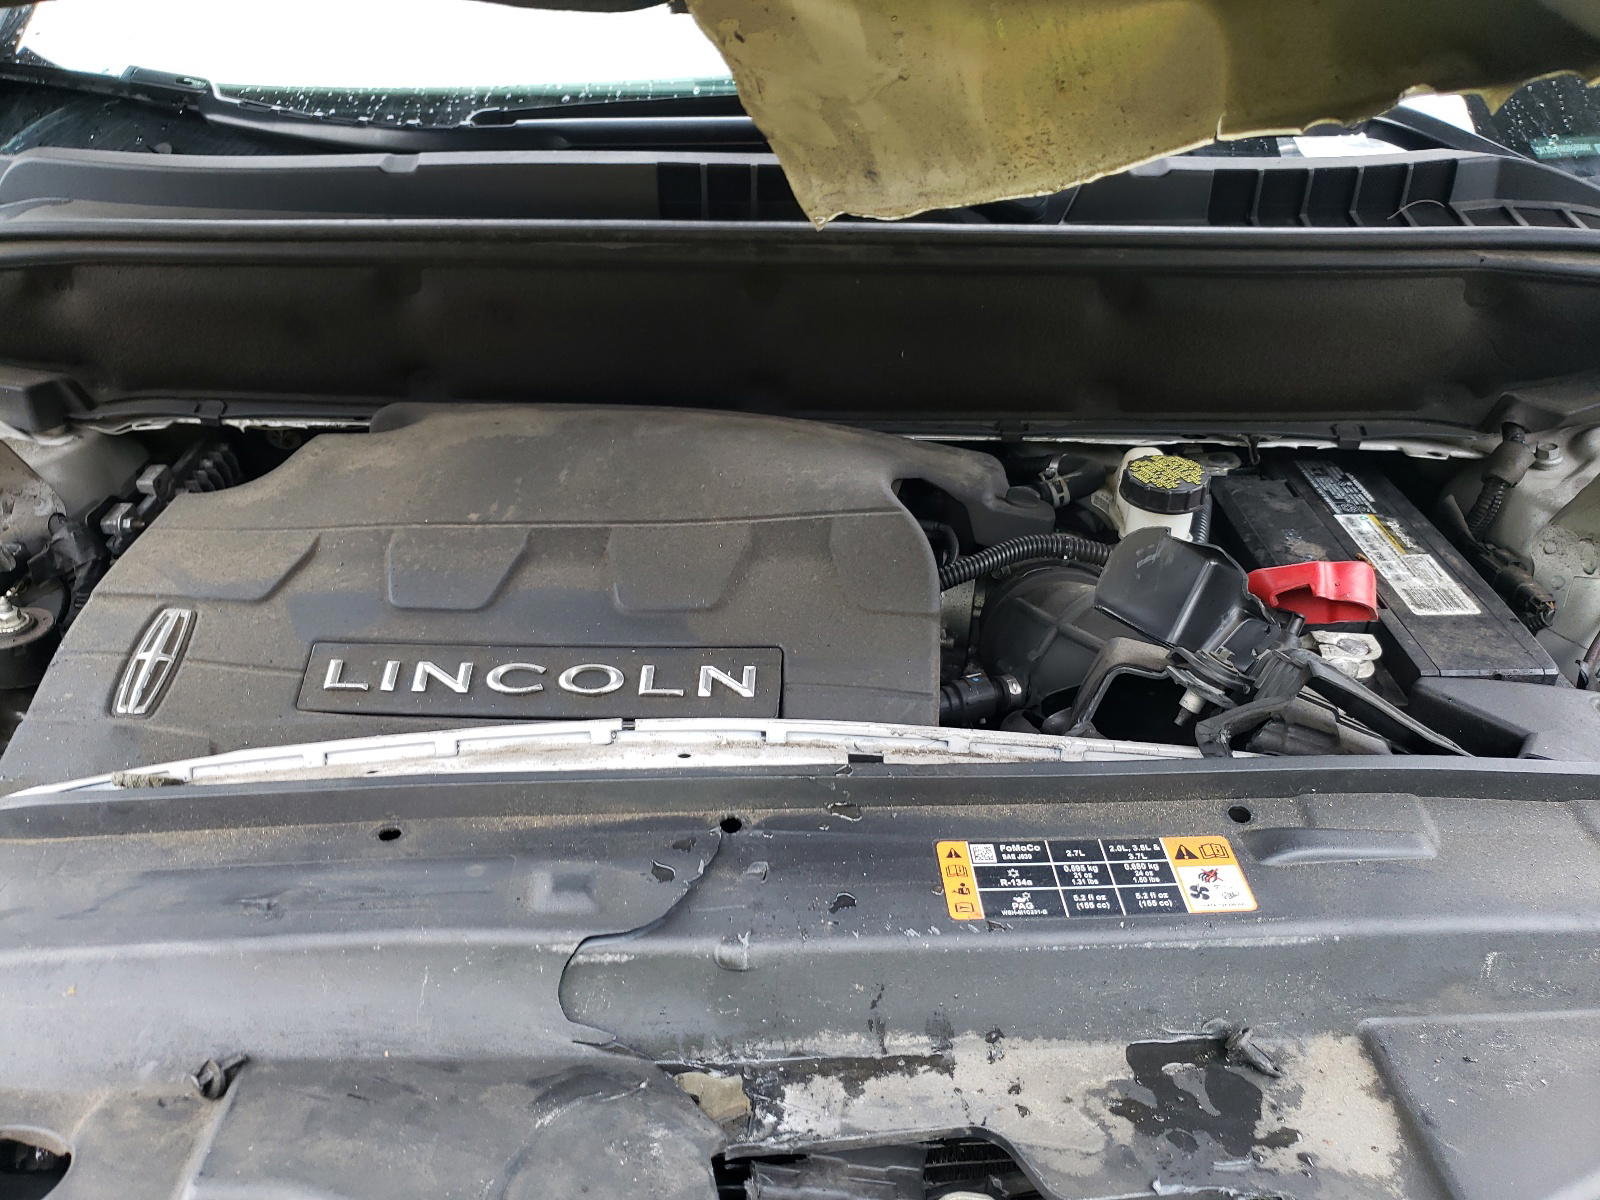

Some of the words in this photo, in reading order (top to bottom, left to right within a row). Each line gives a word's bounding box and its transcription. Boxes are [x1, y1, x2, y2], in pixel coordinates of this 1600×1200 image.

[323, 658, 757, 698] LINCOLN
[999, 844, 1041, 852] FoMoCo
[1152, 843, 1161, 851] &
[1065, 849, 1086, 857] 2.7L
[1127, 852, 1148, 860] 3.7L
[1087, 864, 1099, 873] kg
[1147, 862, 1160, 871] kg
[999, 878, 1033, 887] R-134a
[1072, 894, 1087, 902] 5.2
[1134, 892, 1149, 900] 5.2
[1011, 902, 1034, 910] PAG
[1096, 901, 1110, 910] cc)
[1158, 898, 1173, 908] cc)
